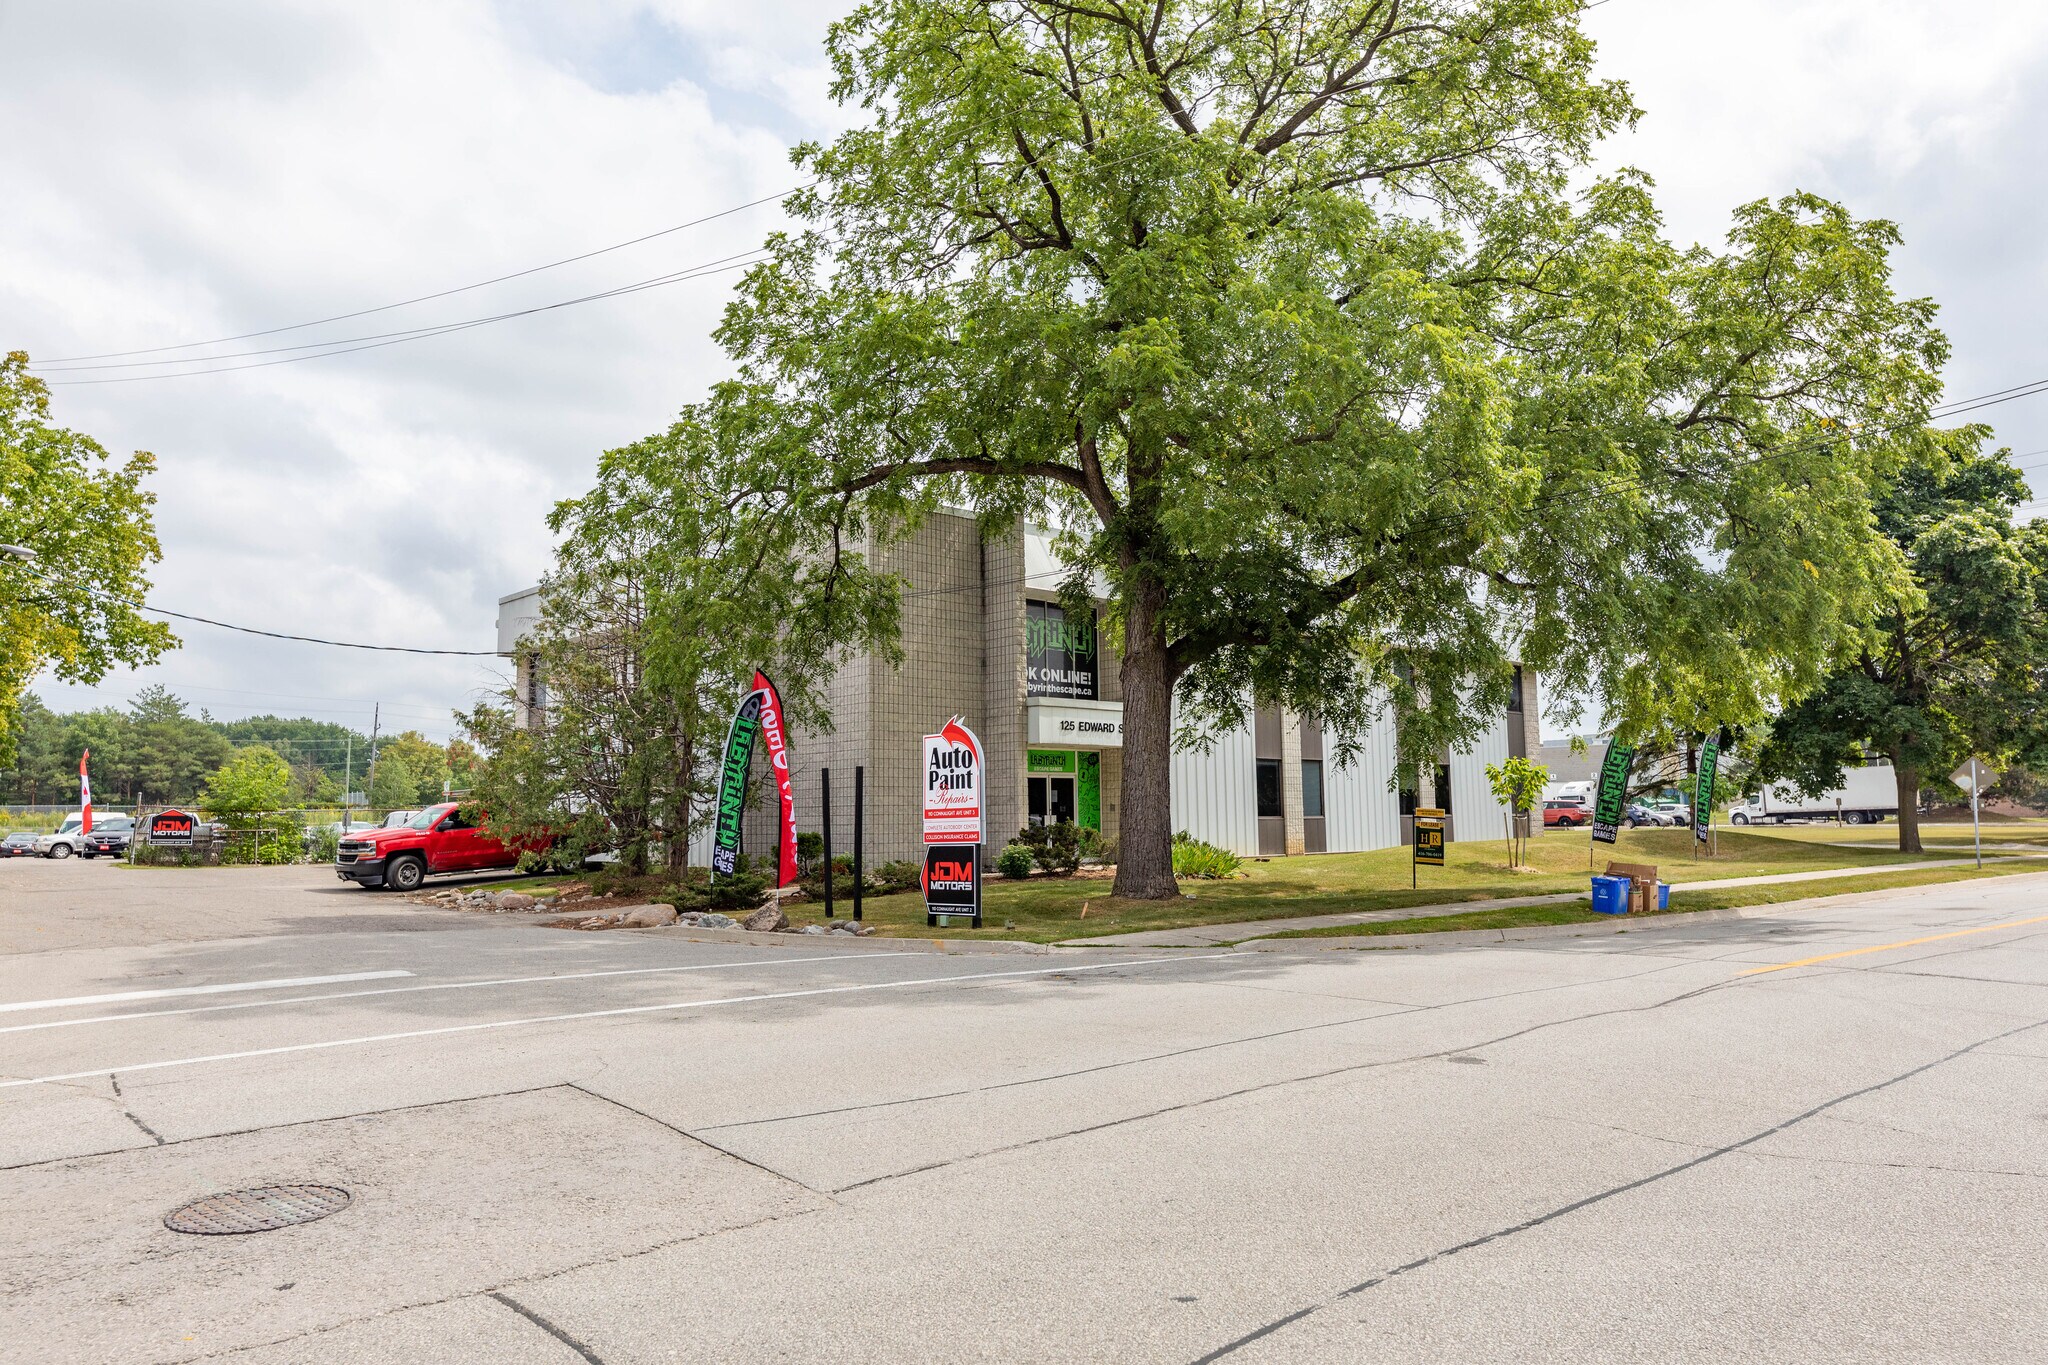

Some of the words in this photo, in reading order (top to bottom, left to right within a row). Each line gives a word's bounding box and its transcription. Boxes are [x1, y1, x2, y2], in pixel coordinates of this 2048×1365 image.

[1040, 668, 1092, 686] ONLINE!
[1060, 720, 1076, 731] 125
[1078, 721, 1116, 733] EDWARD
[929, 747, 973, 770] Auto
[717, 716, 758, 849] LABYRINTH
[929, 768, 974, 791] Paint
[153, 820, 190, 831] JDM
[1594, 822, 1618, 834] ESCAPE
[930, 862, 972, 881] JDM
[930, 881, 972, 890] MOTORS
